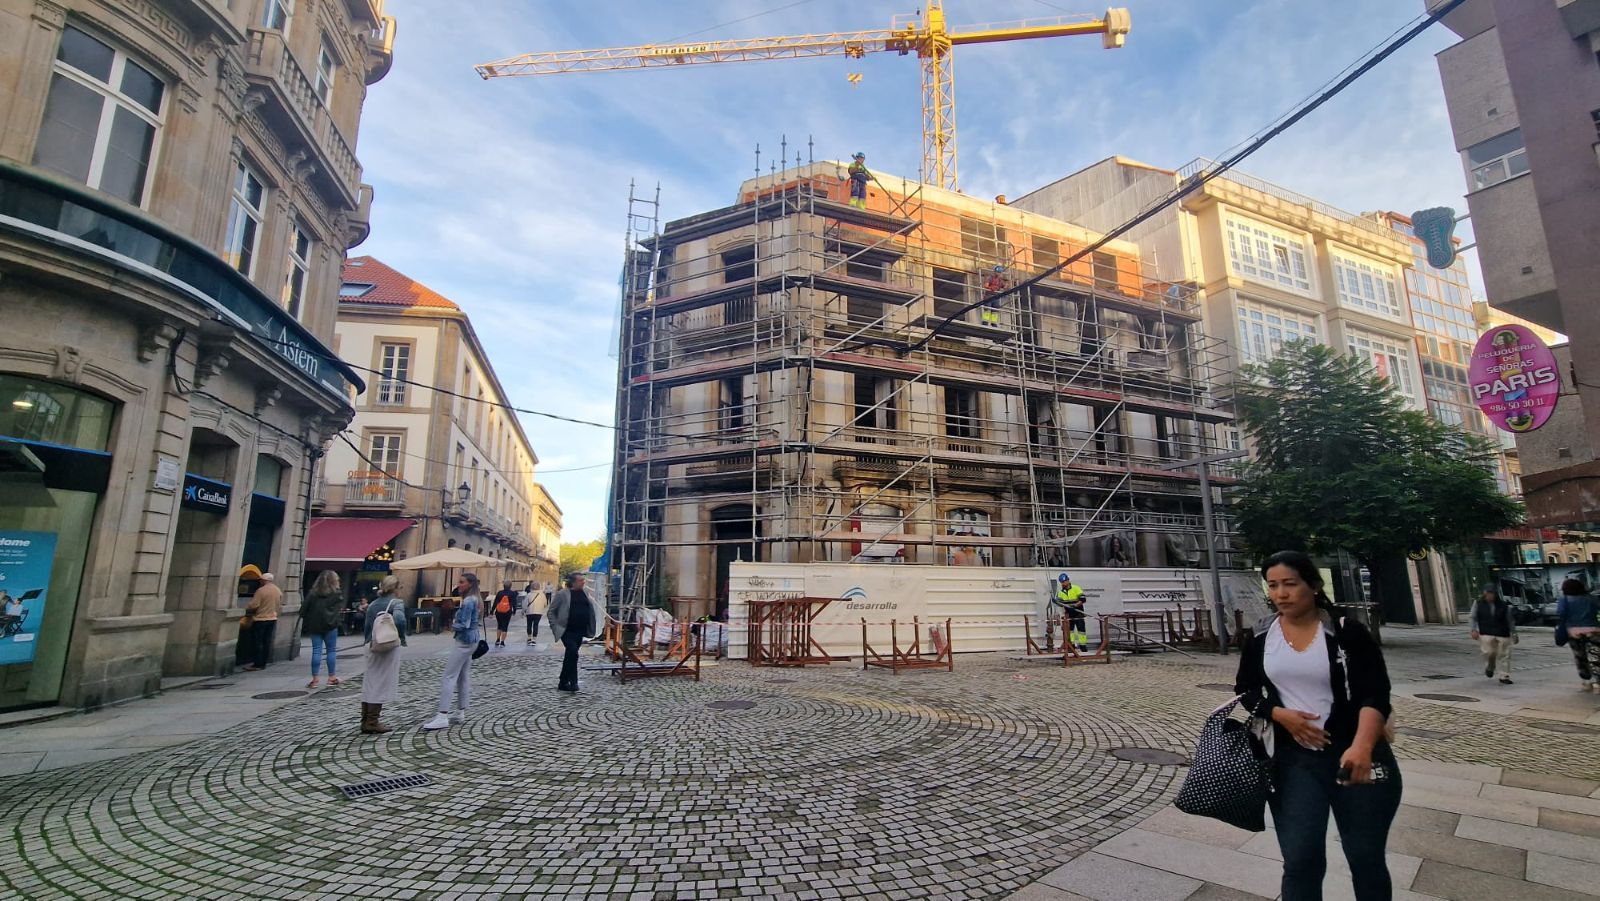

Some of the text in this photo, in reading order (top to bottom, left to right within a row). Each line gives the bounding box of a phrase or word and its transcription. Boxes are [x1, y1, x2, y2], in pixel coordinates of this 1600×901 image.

[274, 325, 318, 378] Astem
[1473, 366, 1556, 399] PARIS
[1508, 400, 1520, 410] 50
[1522, 398, 1534, 408] 30
[1536, 397, 1544, 406] 11
[846, 601, 898, 610] desarrolla
